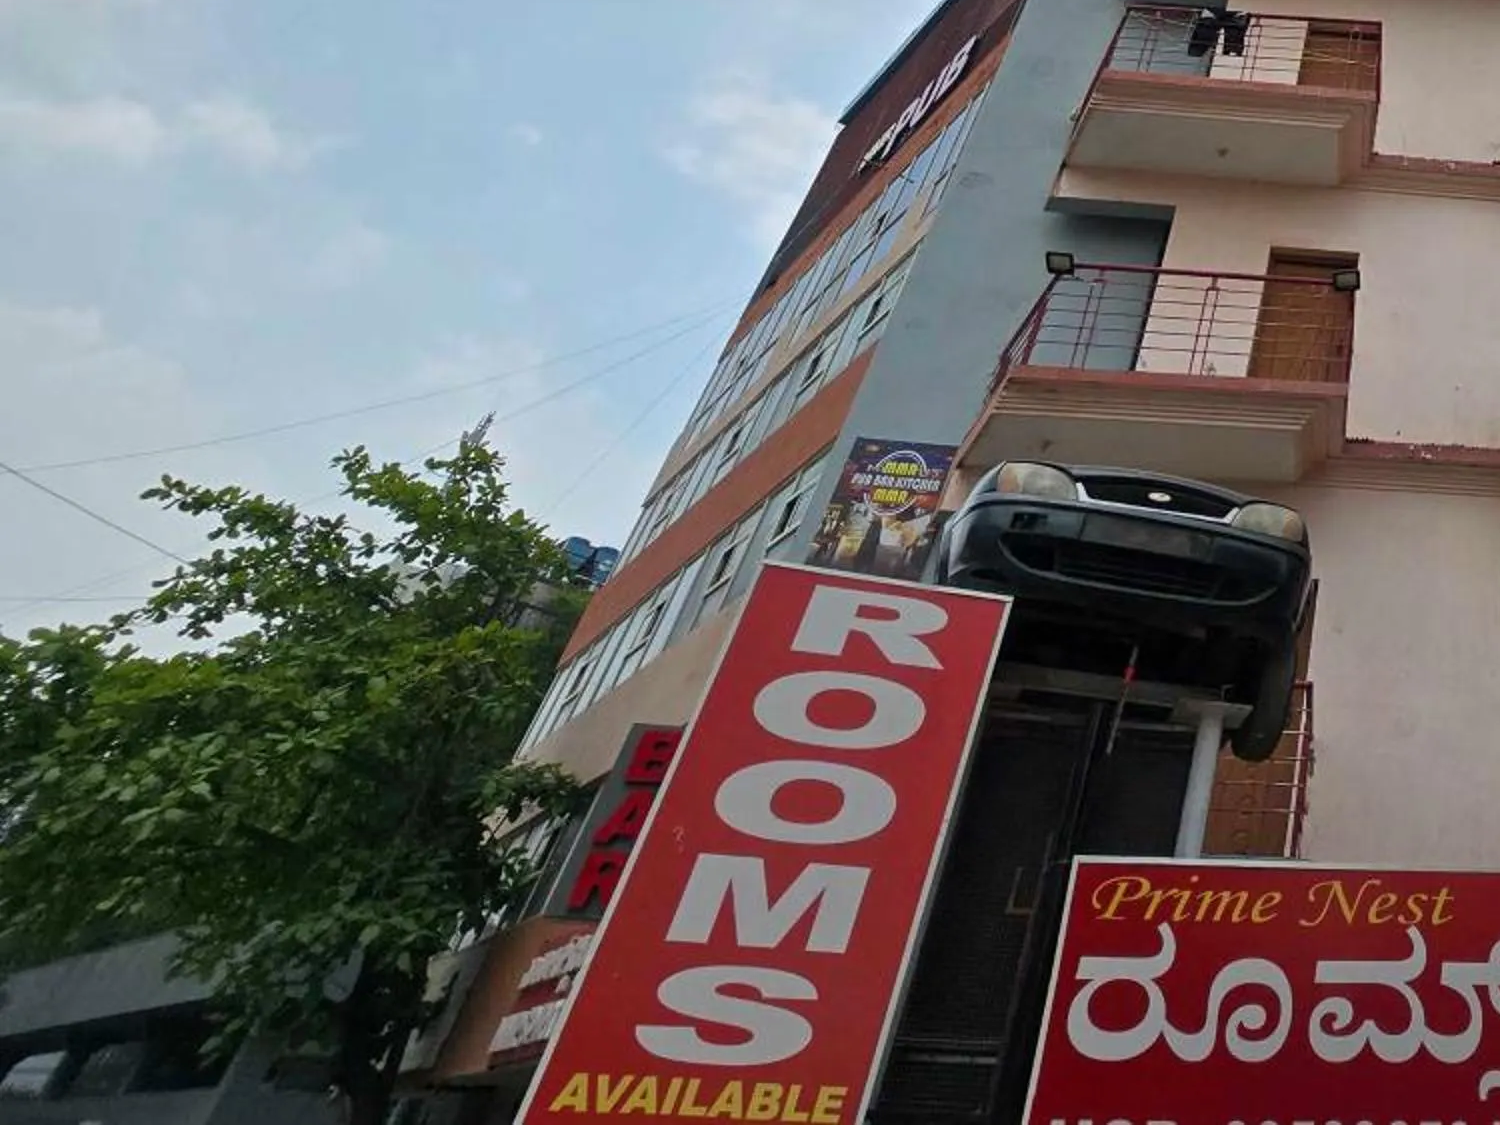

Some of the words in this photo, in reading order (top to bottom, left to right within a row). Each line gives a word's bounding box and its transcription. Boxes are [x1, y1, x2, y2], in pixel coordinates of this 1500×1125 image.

[567, 729, 684, 909] BAR
[635, 584, 949, 1066] ROOMS
[1092, 875, 1283, 924] Prime
[1300, 879, 1454, 926] Nest
[549, 1073, 847, 1124] AVAILABLE
